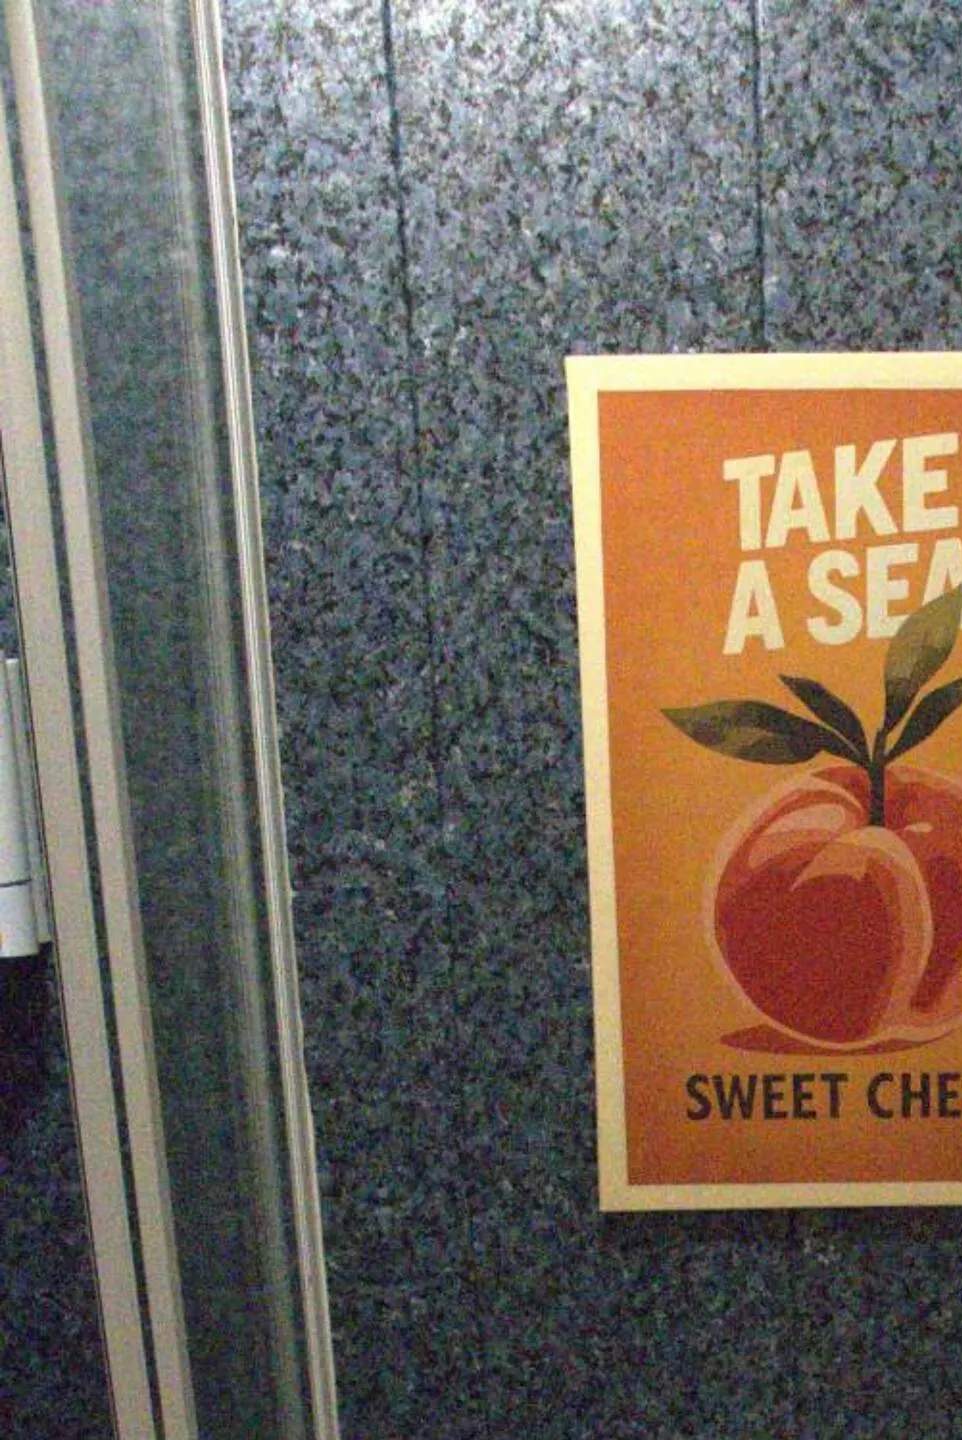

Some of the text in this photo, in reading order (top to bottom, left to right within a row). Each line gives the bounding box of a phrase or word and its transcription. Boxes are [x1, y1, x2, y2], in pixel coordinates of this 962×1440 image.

[723, 432, 959, 551] TAKE
[723, 560, 784, 656] A
[686, 1073, 848, 1121] SWEET
